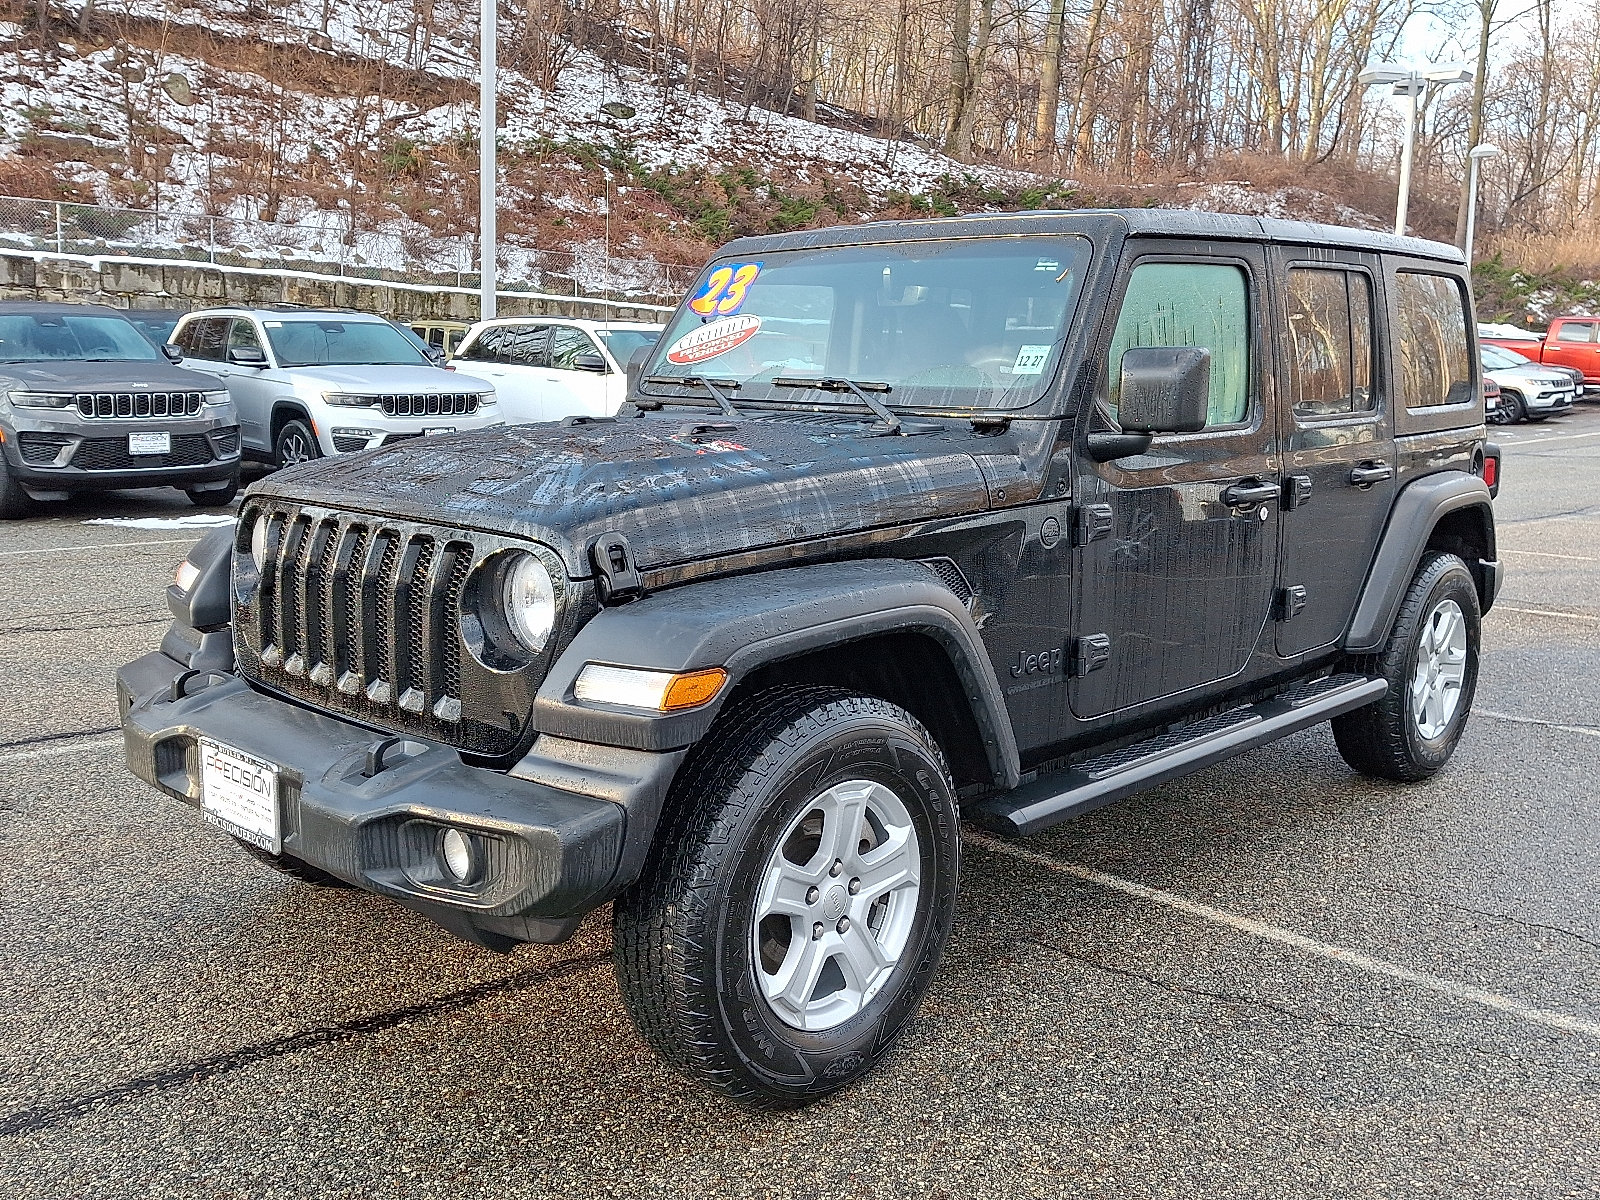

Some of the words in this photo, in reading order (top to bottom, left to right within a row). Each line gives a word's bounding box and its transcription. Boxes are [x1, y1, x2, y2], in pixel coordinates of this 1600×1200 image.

[690, 264, 759, 315] 23
[687, 340, 735, 360] VEHICLE
[1018, 355, 1030, 367] 12
[1031, 355, 1044, 368] 27
[1010, 648, 1060, 678] Jeep
[206, 755, 271, 797] PRECISION
